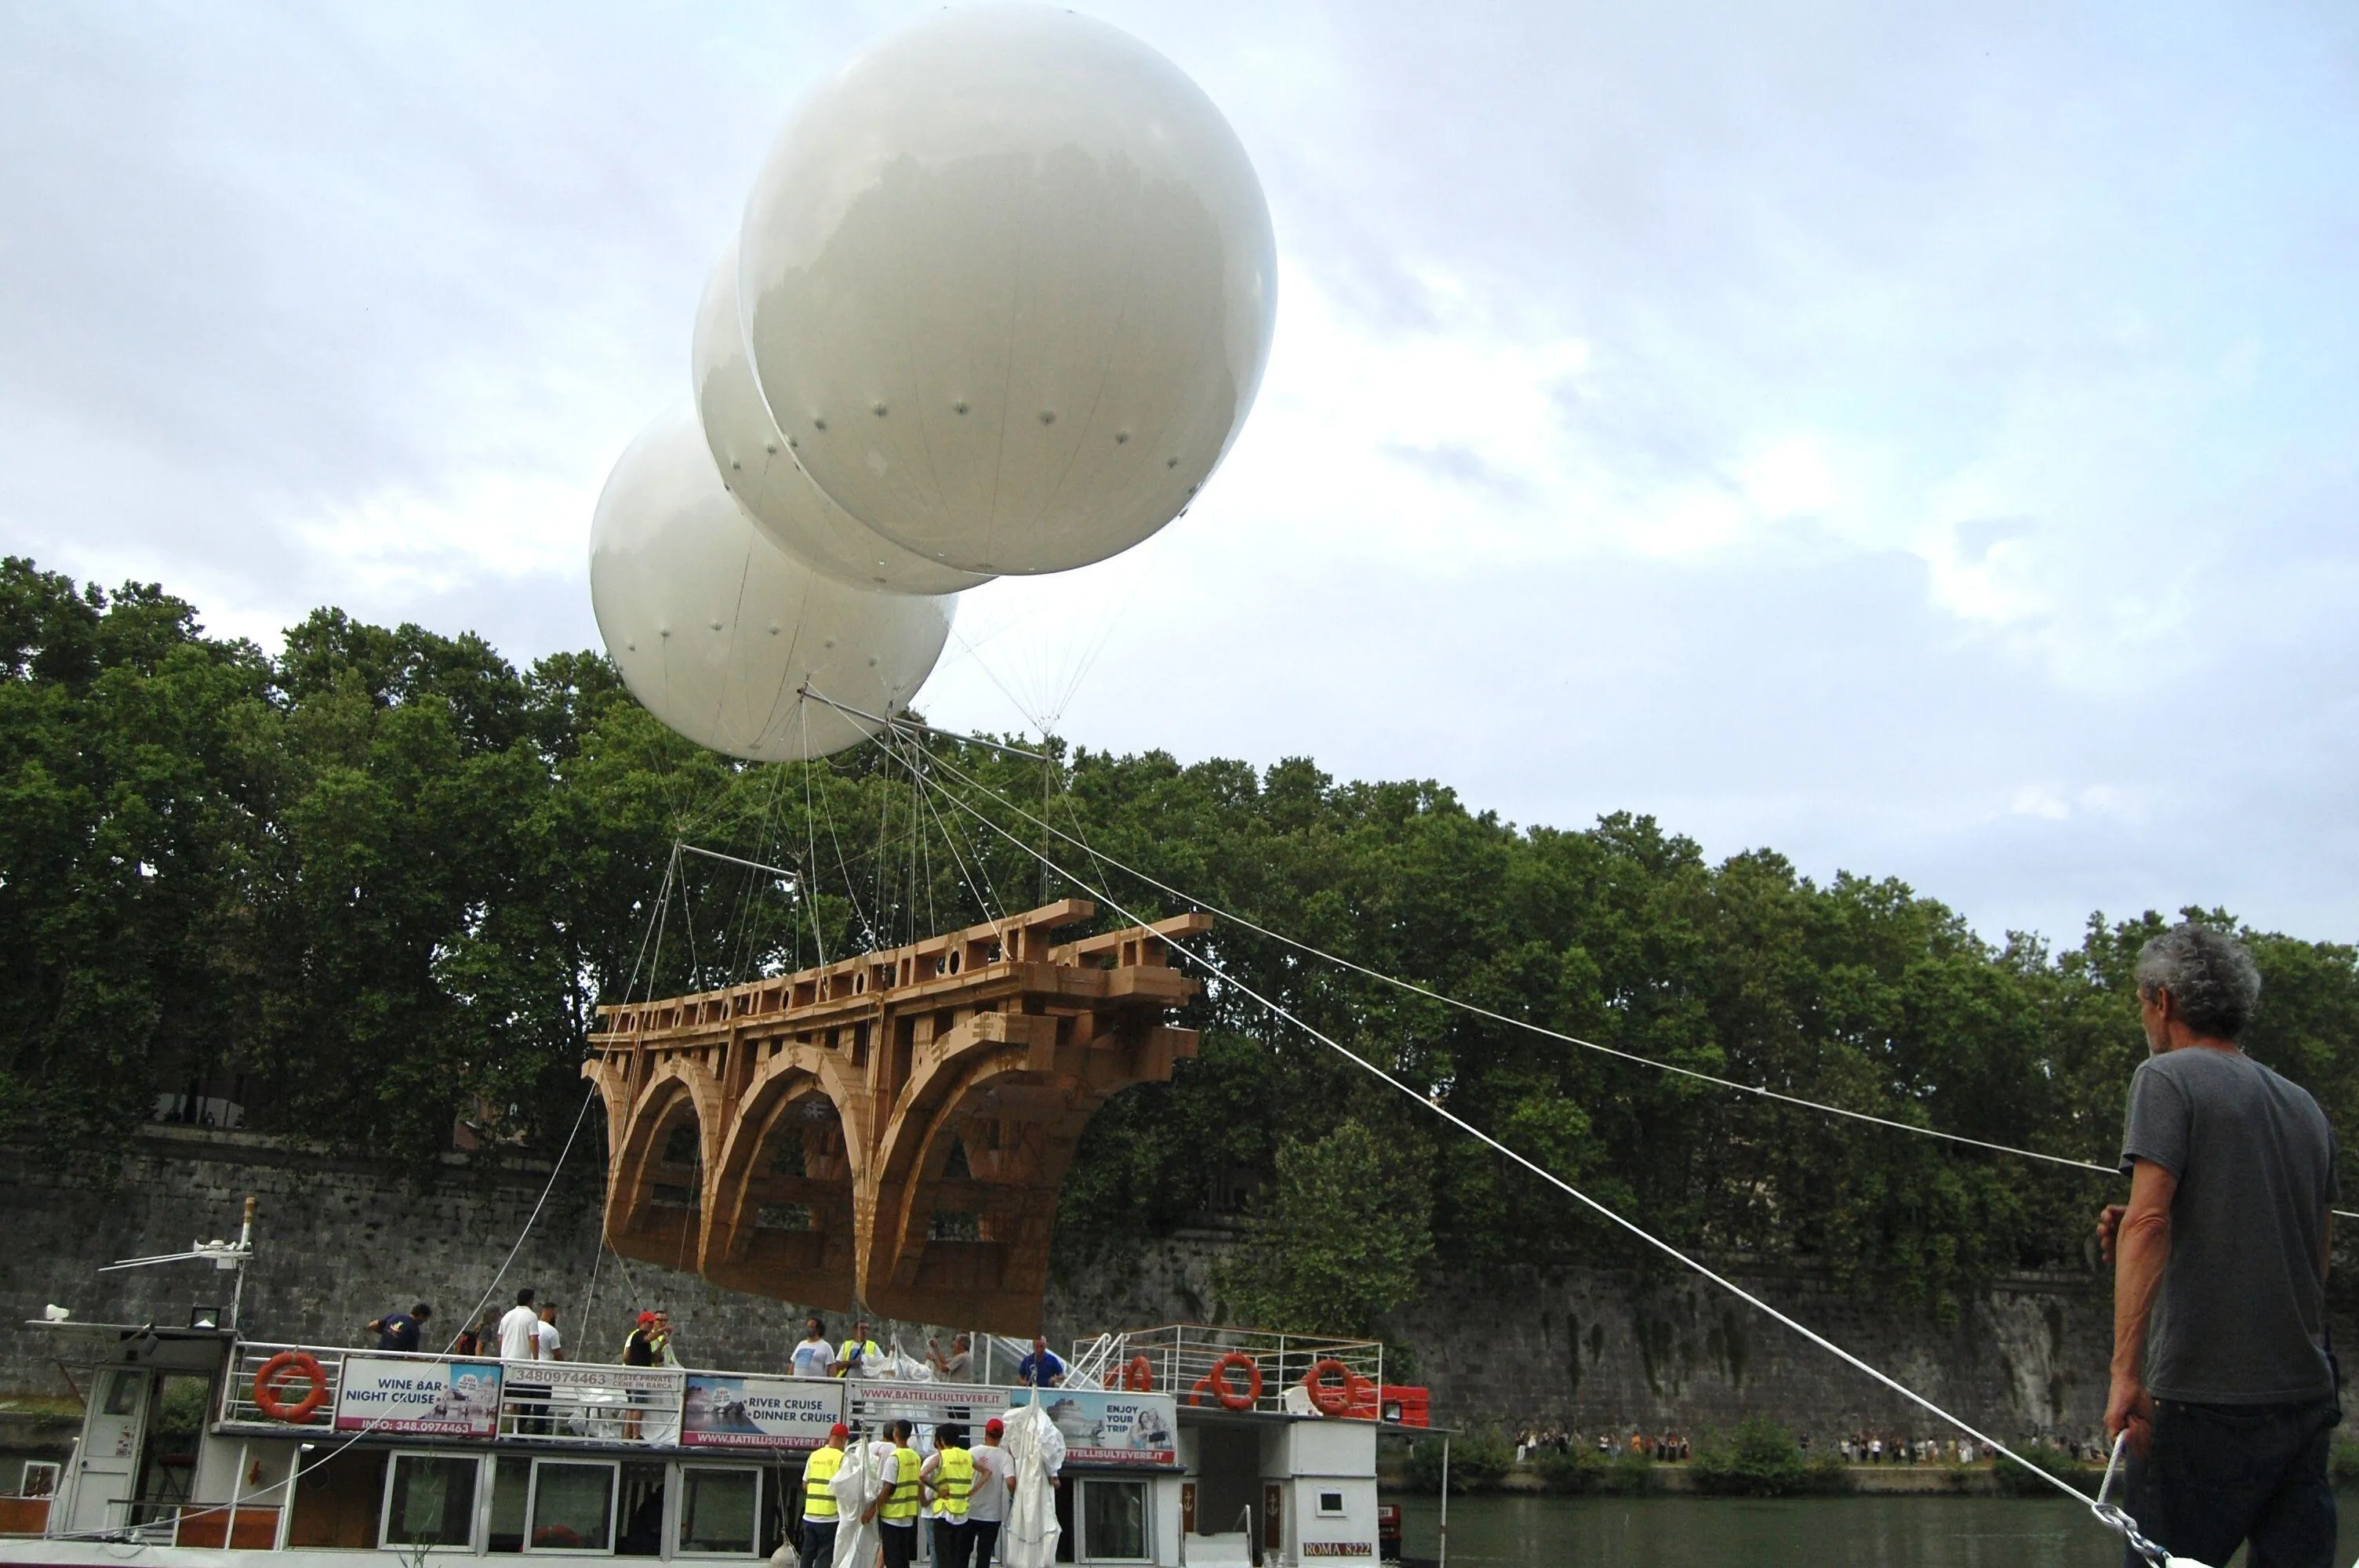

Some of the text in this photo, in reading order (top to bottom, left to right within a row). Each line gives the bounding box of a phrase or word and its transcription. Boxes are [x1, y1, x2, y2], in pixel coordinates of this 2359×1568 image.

[516, 1370, 606, 1385] 3480974463
[378, 1378, 442, 1392] WINE BAR
[346, 1390, 435, 1404] NIGHT CRUISE
[860, 1388, 1000, 1404] WWW.BATTELLISULTEVERE.IT
[749, 1397, 823, 1410] RIVER CRUISE
[1107, 1405, 1139, 1414] ENJOY
[753, 1410, 838, 1423] DINNER CRUISE
[362, 1420, 469, 1434] INFO: 348.0974463
[697, 1433, 827, 1447] WWW.BATTELLISULTEVERE.IT
[1067, 1449, 1164, 1460] TTELLISULTEVERE.IT
[1305, 1543, 1371, 1555] ROMA 8222
